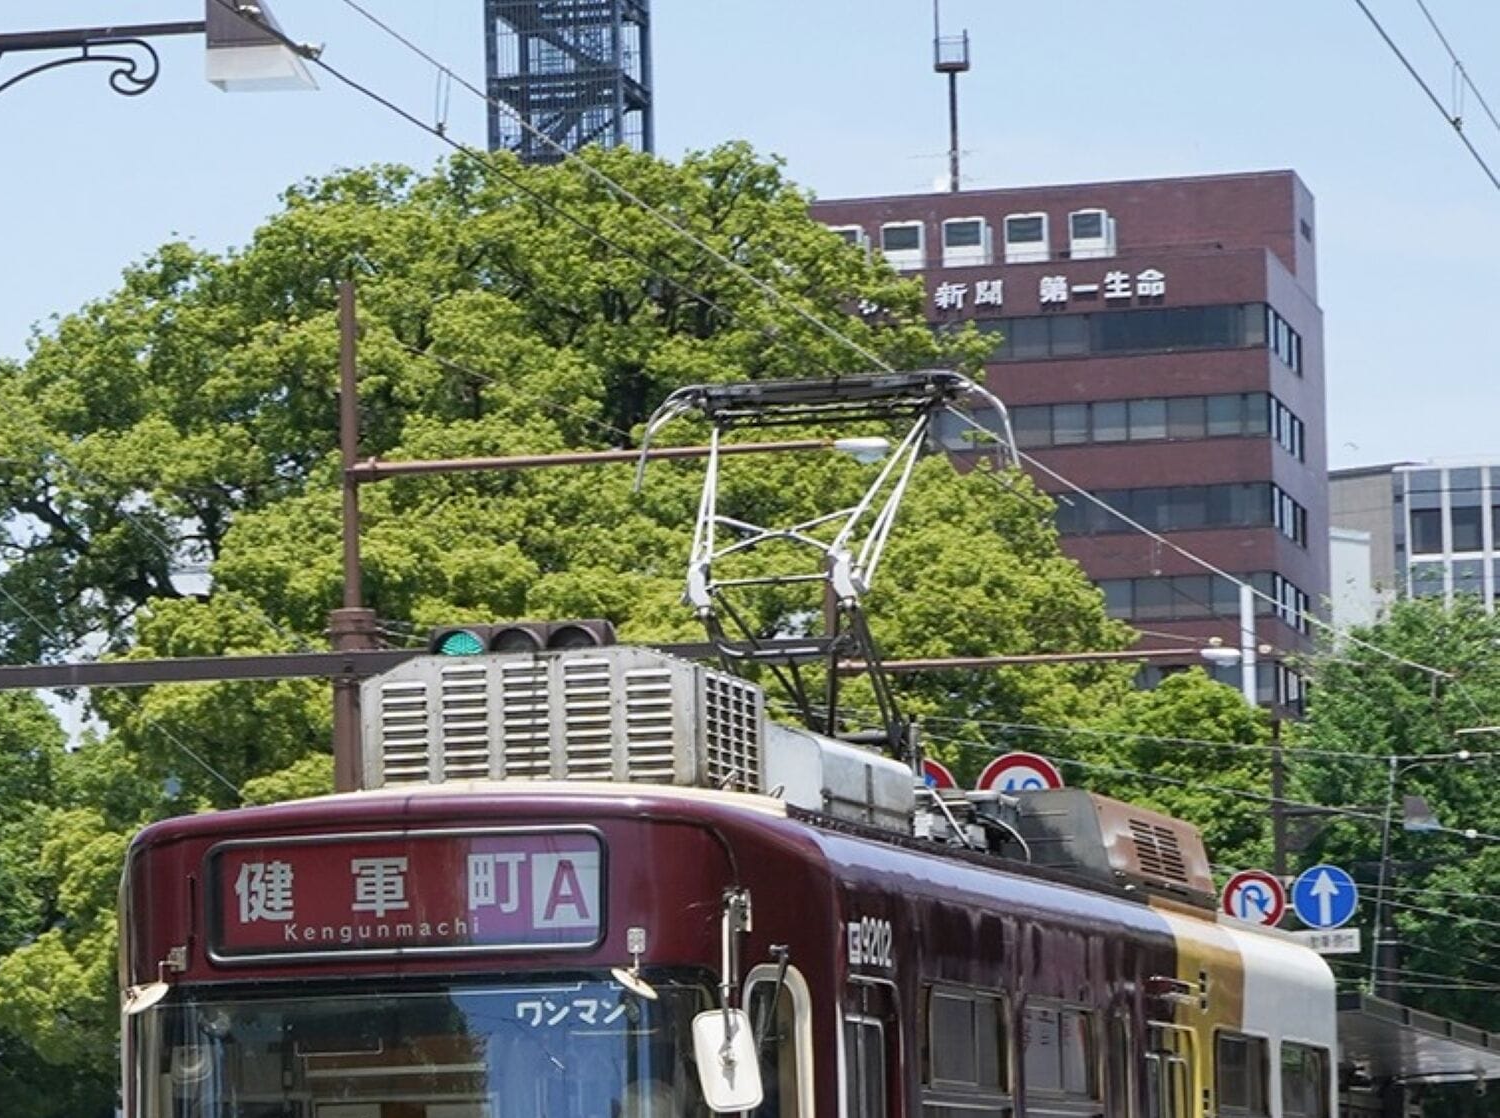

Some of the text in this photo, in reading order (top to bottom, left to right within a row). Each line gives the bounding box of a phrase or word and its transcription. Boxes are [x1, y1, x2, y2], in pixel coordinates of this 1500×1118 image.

[1039, 268, 1166, 304] 第一生命
[235, 852, 591, 923] 健軍町 A
[284, 917, 480, 944] Kengunmachi
[516, 997, 627, 1028] ワンマン
